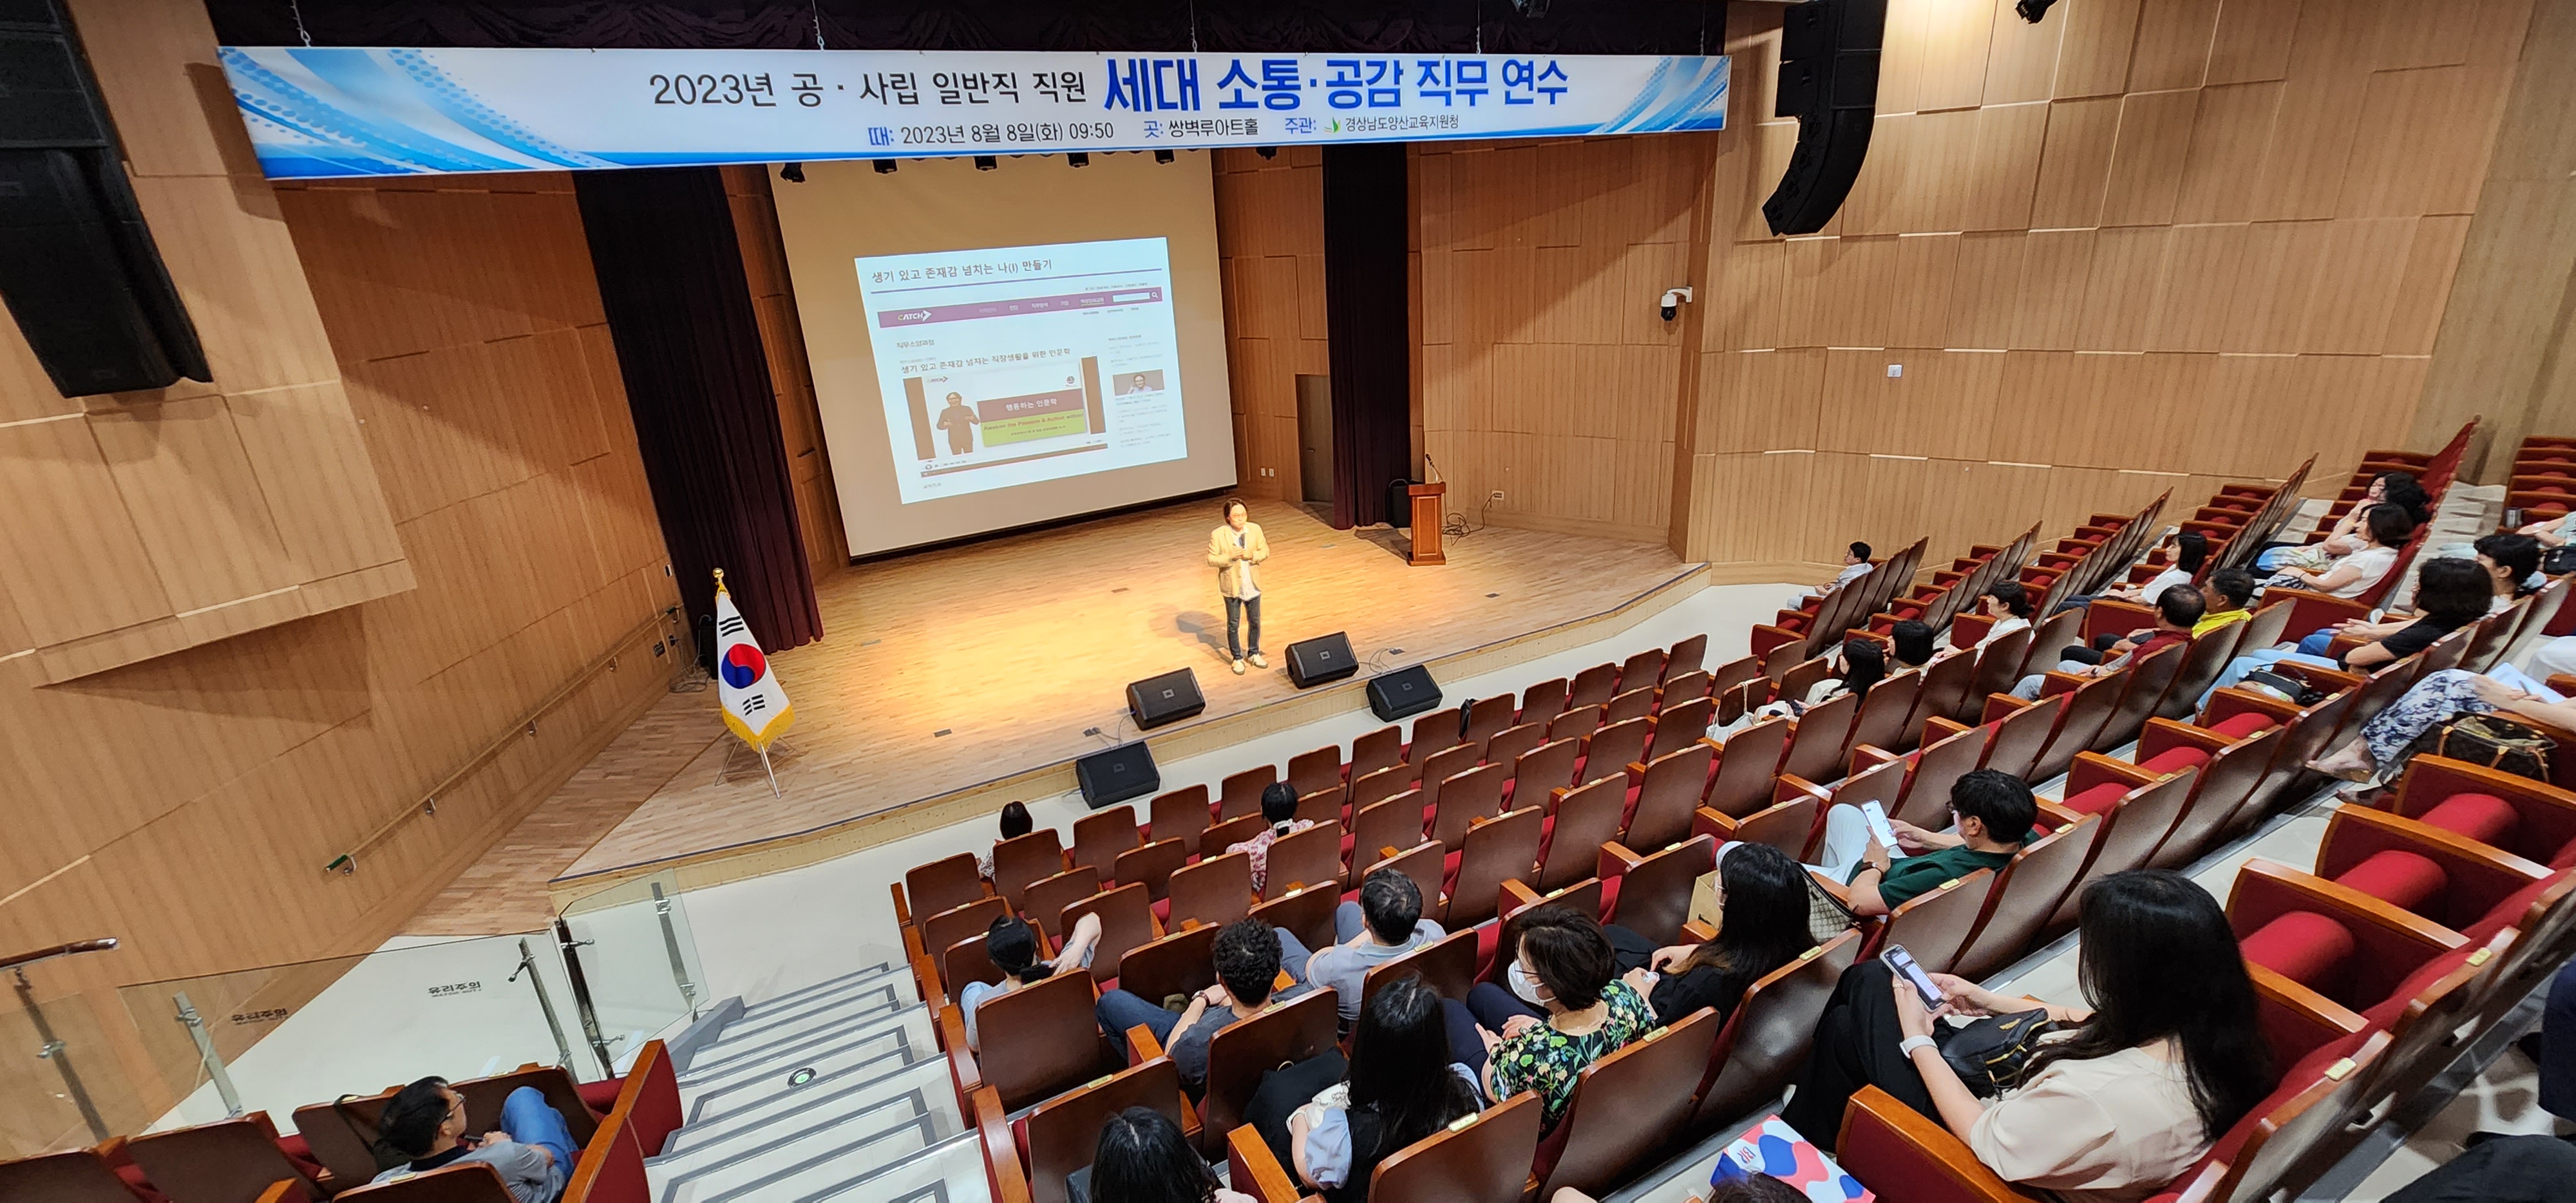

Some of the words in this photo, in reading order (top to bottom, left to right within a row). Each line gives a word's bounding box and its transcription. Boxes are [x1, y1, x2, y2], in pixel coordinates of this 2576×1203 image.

[649, 73, 777, 107] 2023년
[791, 73, 824, 107] 공
[860, 71, 920, 106] 사립
[933, 71, 1019, 104] 일반직
[1032, 71, 1087, 103] 직원
[1104, 59, 1201, 112] 세대
[1417, 59, 1488, 107] 직무
[1502, 59, 1569, 106] 연수
[868, 127, 895, 146] 때:
[902, 126, 965, 144] 2023년
[971, 124, 1001, 143] 8월
[1006, 122, 1063, 143] 8일(화)
[1069, 122, 1114, 140] 09:50
[1143, 120, 1164, 138] 곳:
[1168, 118, 1259, 138] 쌍벽루아트홀
[1284, 117, 1317, 135] 주관:
[1345, 114, 1460, 131] 경상남도양산교육지원청
[872, 270, 895, 283] 생기
[899, 269, 922, 281] 있고
[925, 266, 958, 279] 존재감
[962, 263, 994, 276] 넘치는
[1022, 259, 1052, 272] 만들기
[898, 312, 923, 321] CATCH
[902, 365, 918, 374] 생기
[920, 363, 936, 372] 있고
[940, 360, 963, 369] 존재감
[966, 357, 989, 366] 넘치는
[992, 352, 1028, 362] 직장생활을
[1032, 350, 1046, 359] 위한
[1049, 348, 1070, 357] 인문학
[1036, 398, 1057, 408] 인문학
[428, 981, 481, 994] 유리주의
[231, 1008, 288, 1021] 유리주의
